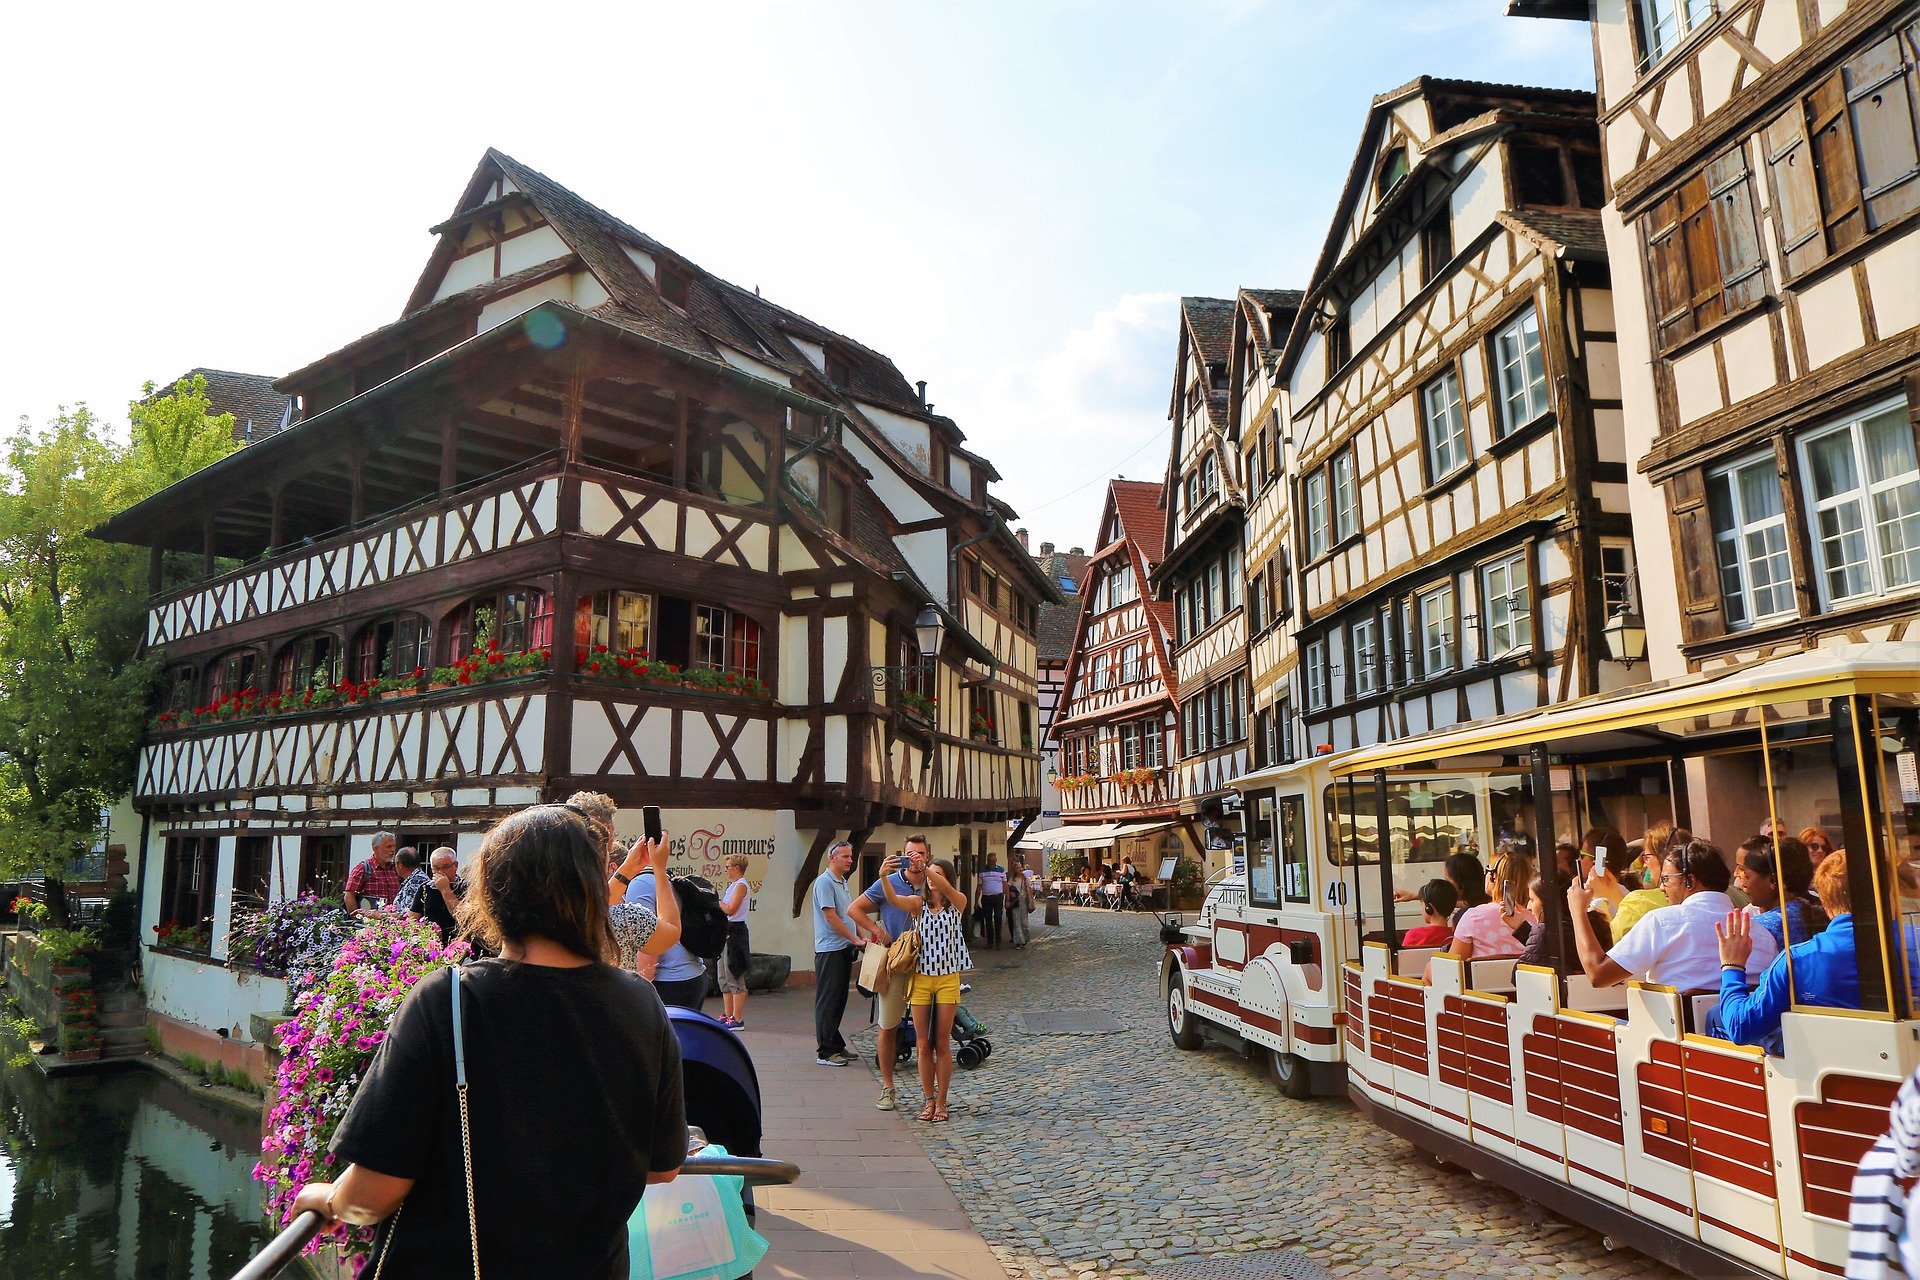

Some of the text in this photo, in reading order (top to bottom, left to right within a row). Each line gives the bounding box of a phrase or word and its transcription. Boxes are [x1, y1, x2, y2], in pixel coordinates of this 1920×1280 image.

[663, 829, 686, 860] es
[687, 823, 776, 861] Tanneurs
[702, 864, 722, 878] 1572
[1327, 881, 1347, 906] 40
